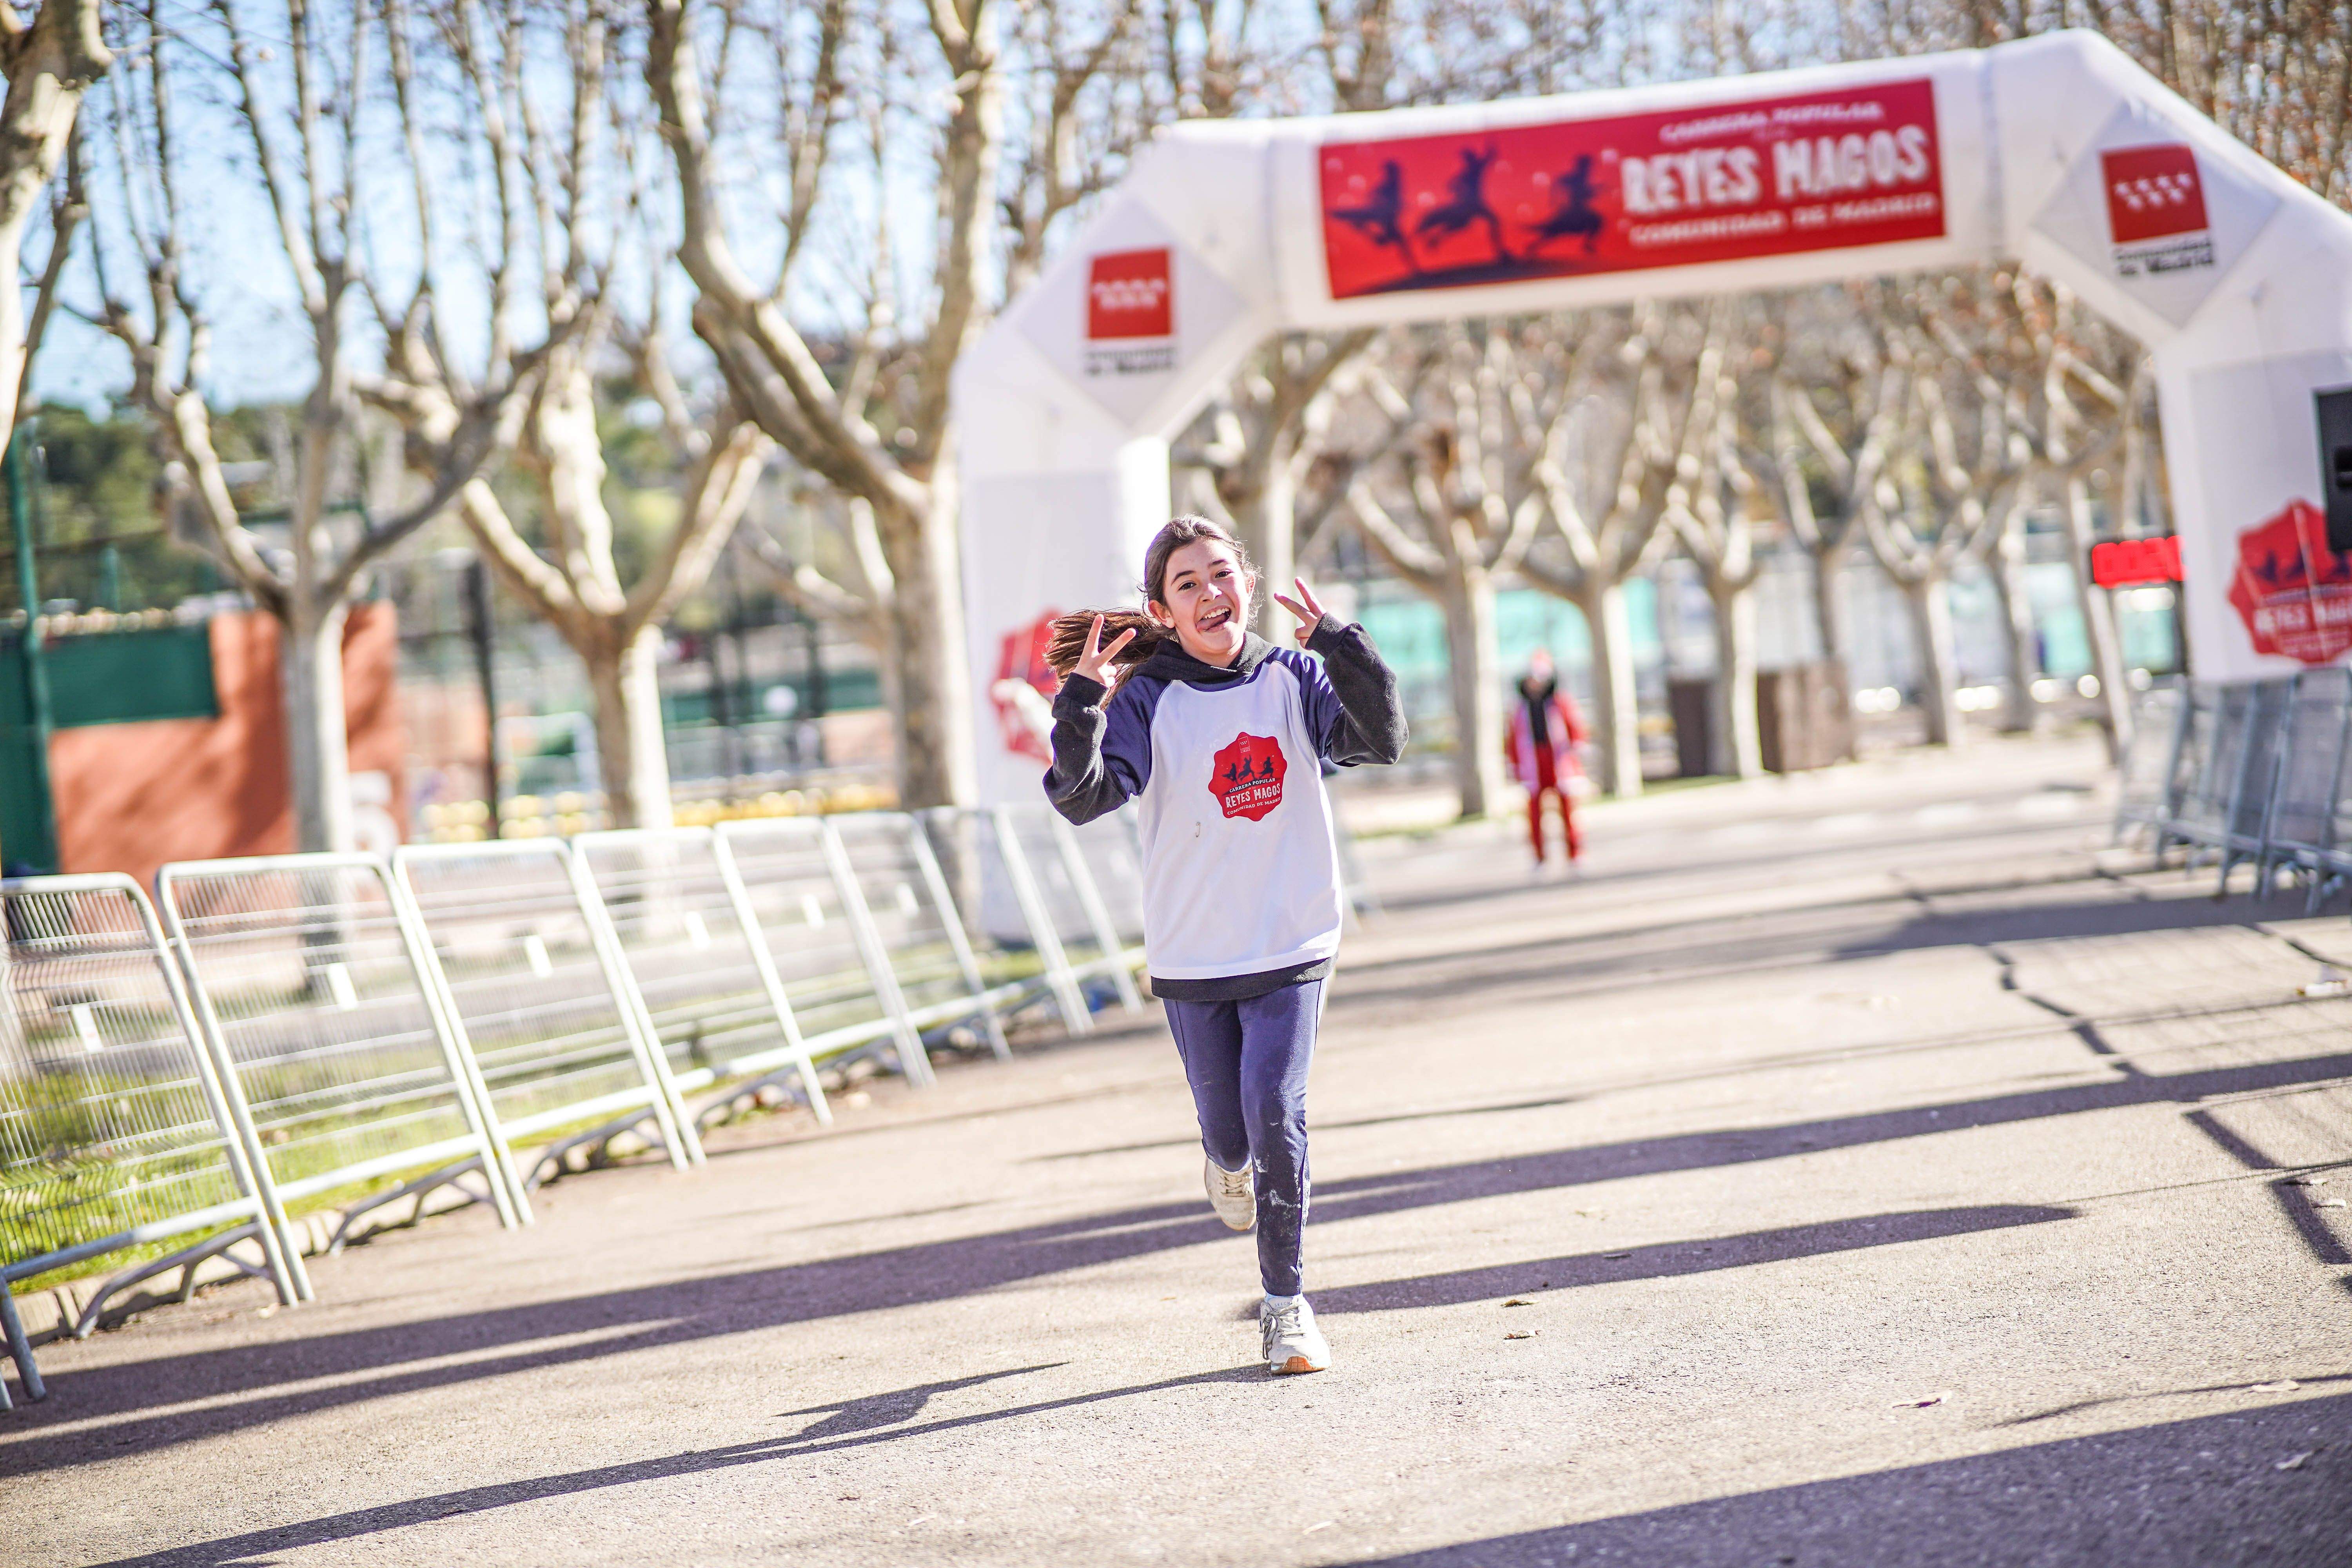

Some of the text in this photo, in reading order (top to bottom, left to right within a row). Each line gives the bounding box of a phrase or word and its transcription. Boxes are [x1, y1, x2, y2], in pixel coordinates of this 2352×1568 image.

[1620, 124, 1929, 216] REYES MAGOS
[1225, 783, 1280, 808] REYES MAGOS
[1229, 782, 1251, 793] CARRERA
[1227, 804, 1256, 815] COMUNIDAD
[1264, 797, 1281, 805] MADRID
